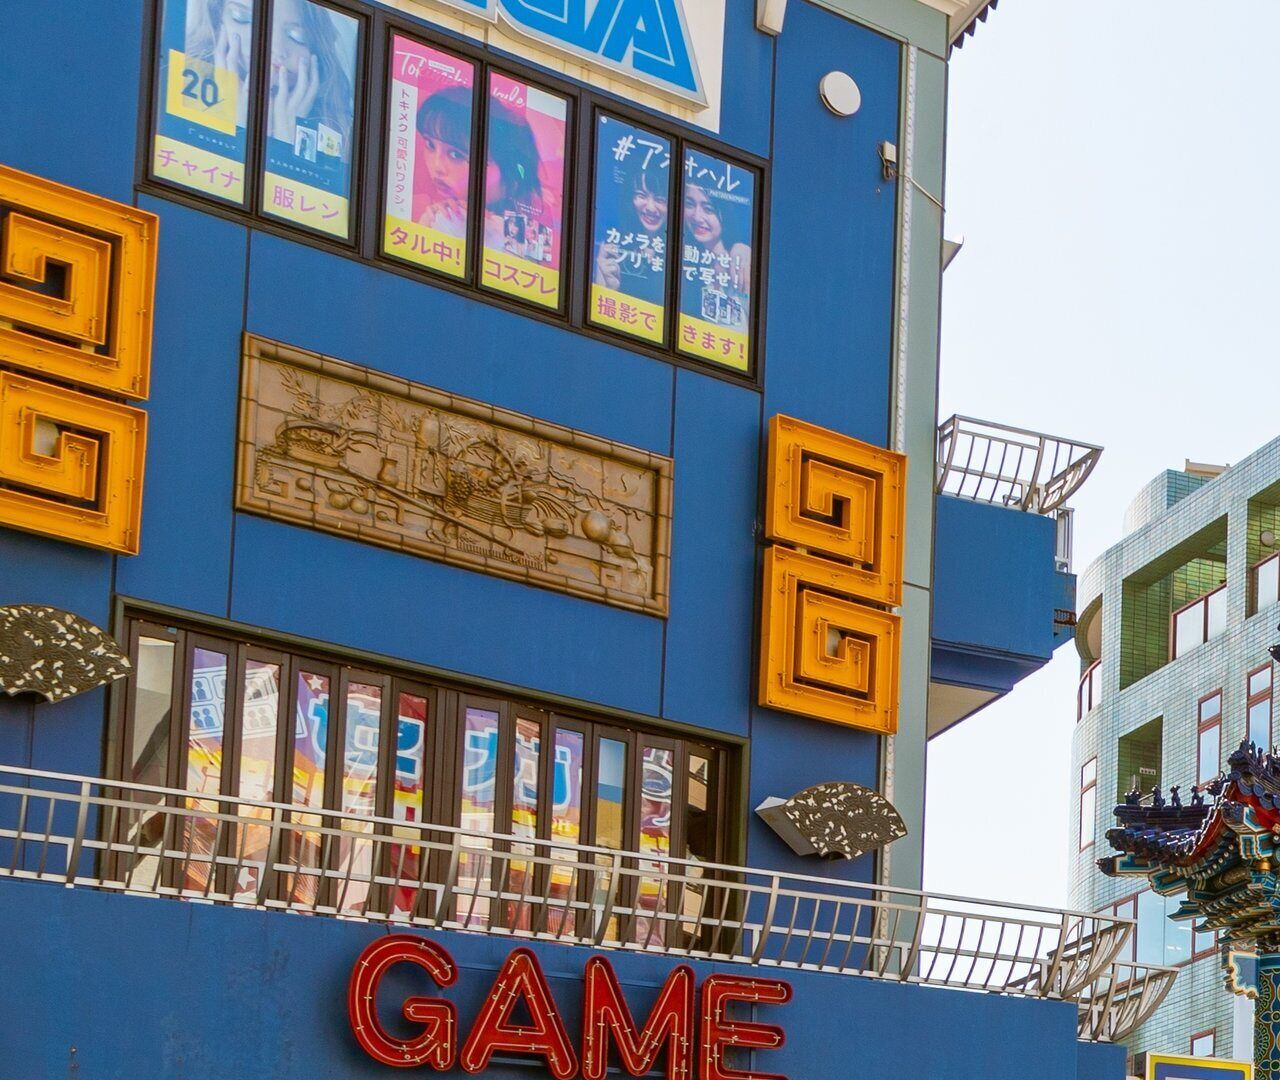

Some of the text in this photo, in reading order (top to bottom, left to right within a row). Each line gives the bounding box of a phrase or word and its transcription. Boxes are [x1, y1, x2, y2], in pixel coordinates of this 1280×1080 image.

[182, 68, 220, 108] 20
[157, 149, 241, 188] チャイナ
[273, 185, 340, 219] 服レン
[390, 226, 461, 266] タル中!
[606, 228, 740, 269] カメラを 動かせ!
[485, 258, 556, 294] コスプレ
[597, 295, 657, 331] 撮影で
[682, 325, 745, 360] きます!
